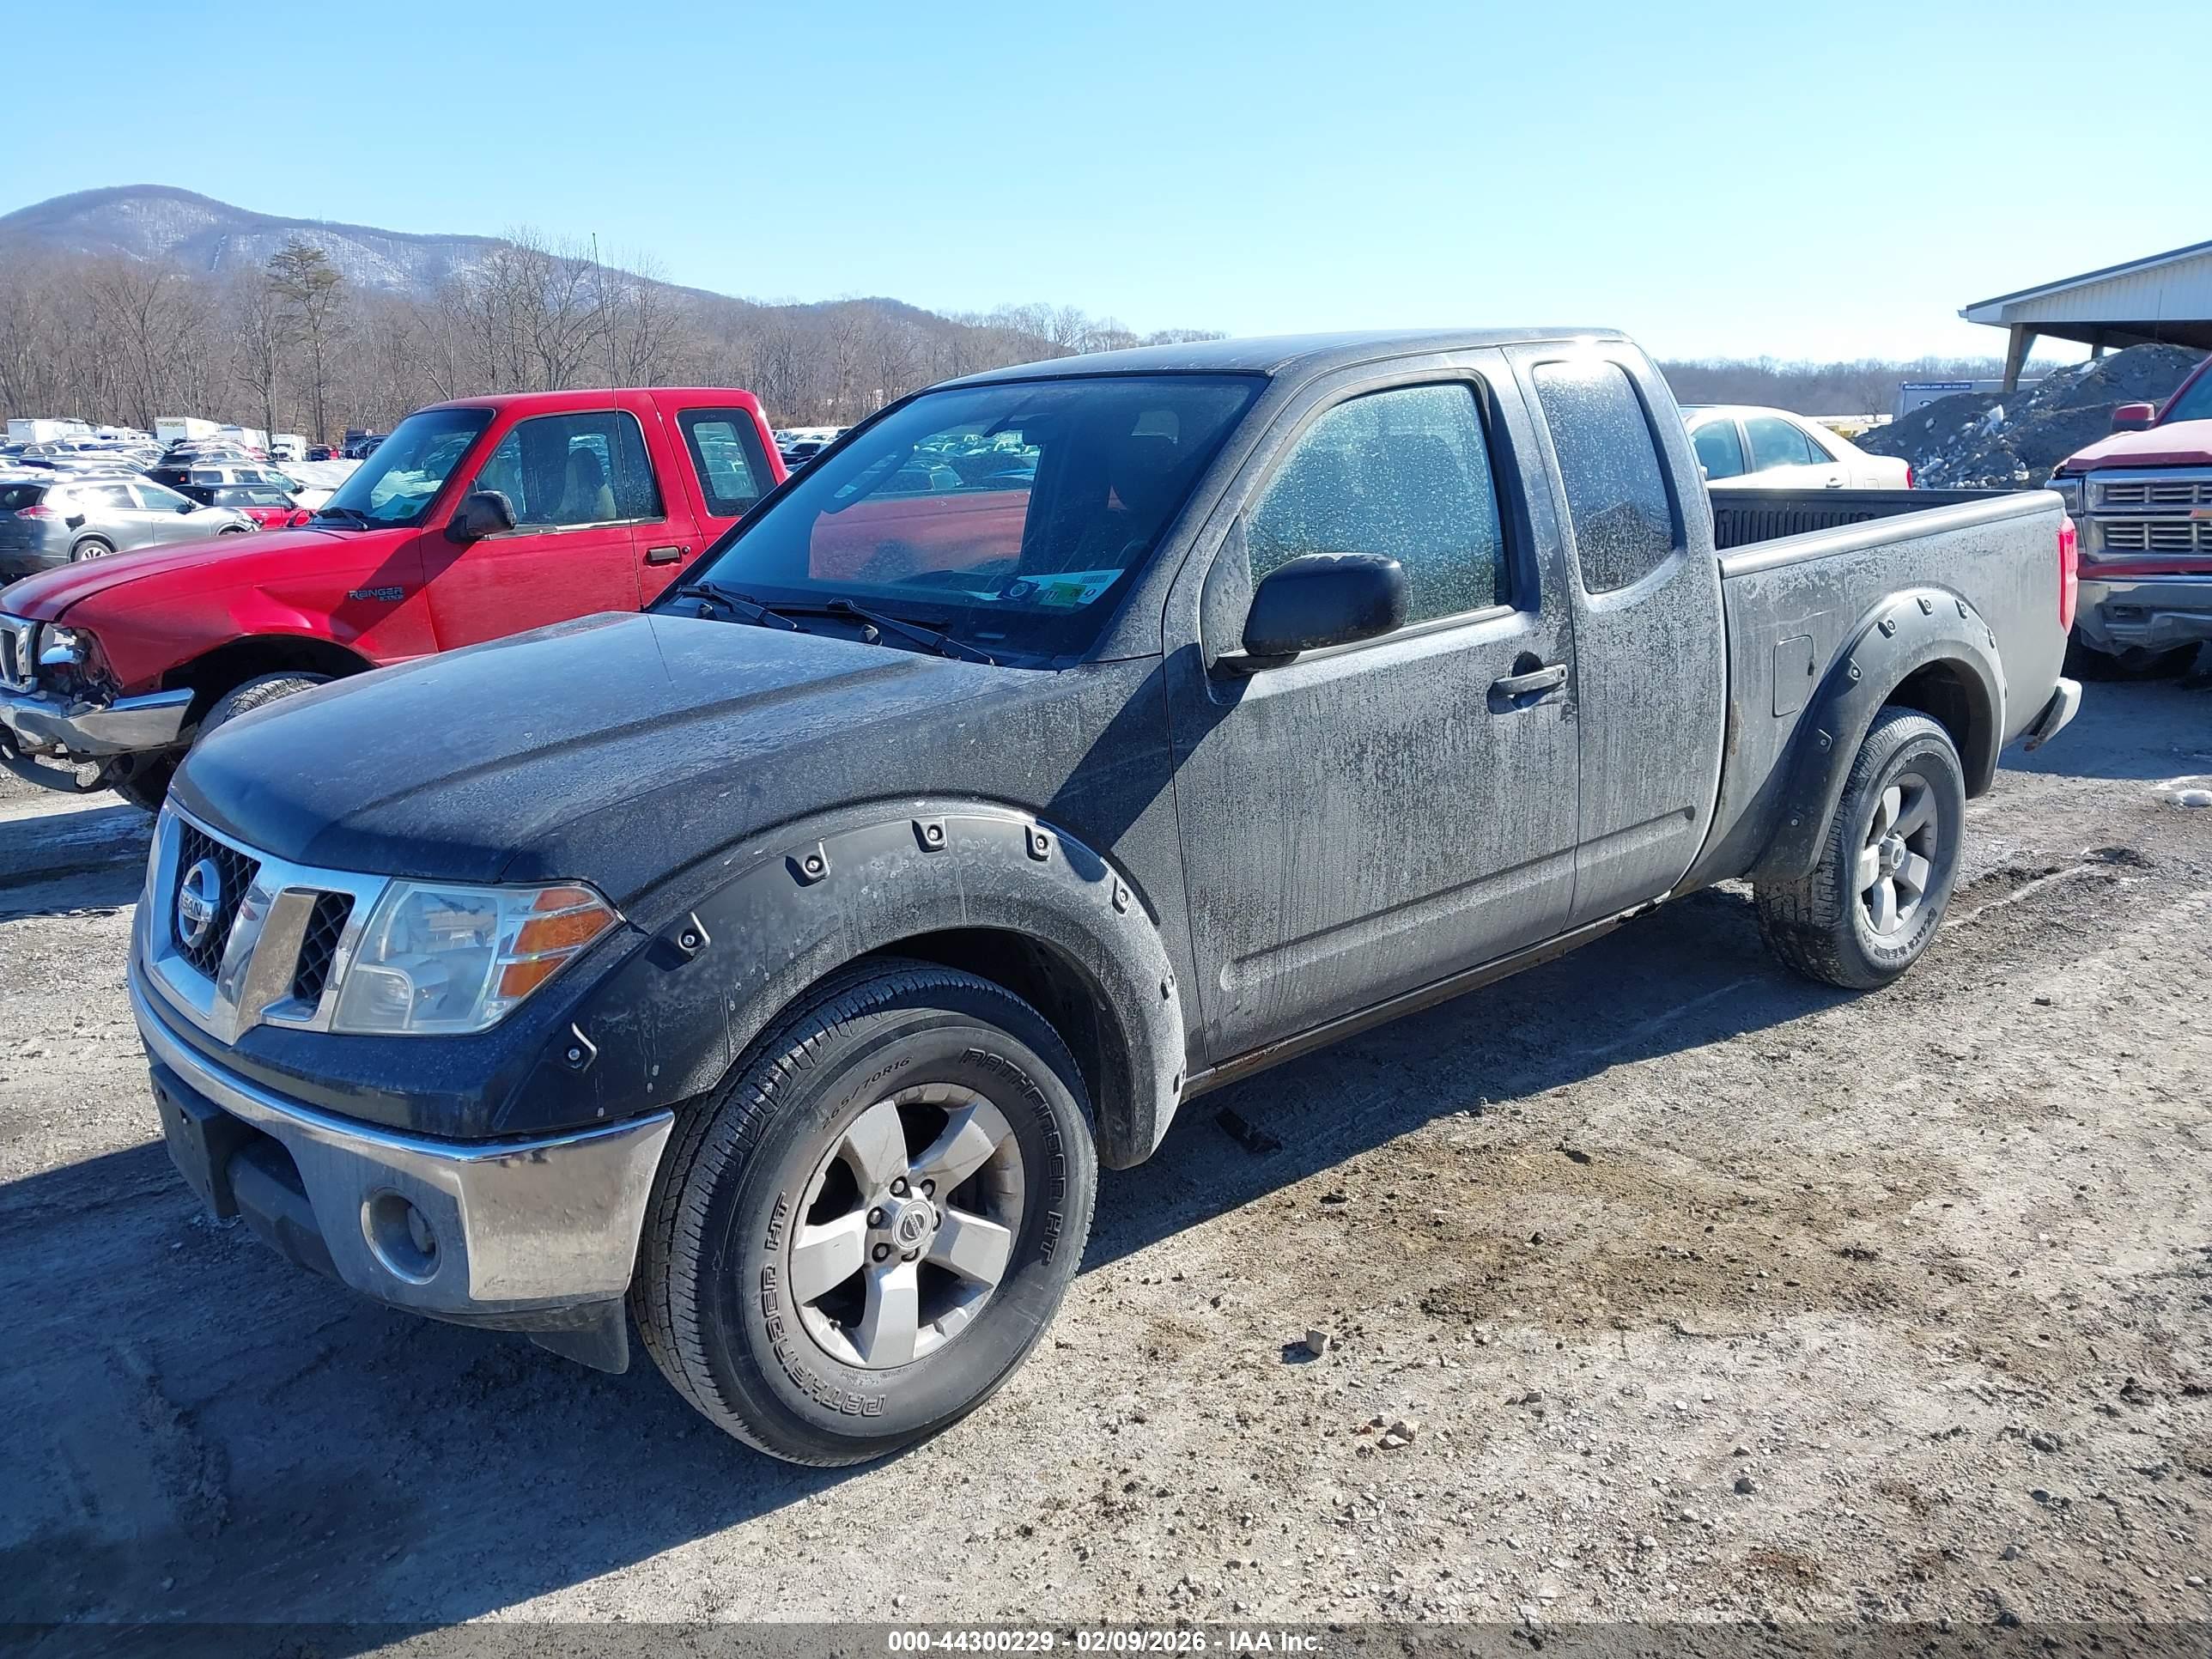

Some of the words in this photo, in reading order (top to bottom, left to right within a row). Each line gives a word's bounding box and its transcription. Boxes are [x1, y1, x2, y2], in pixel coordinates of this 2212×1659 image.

[349, 586, 404, 600] RANGER
[960, 1048, 1066, 1202] PATHFINDER
[761, 1264, 887, 1417] PATHFINDER
